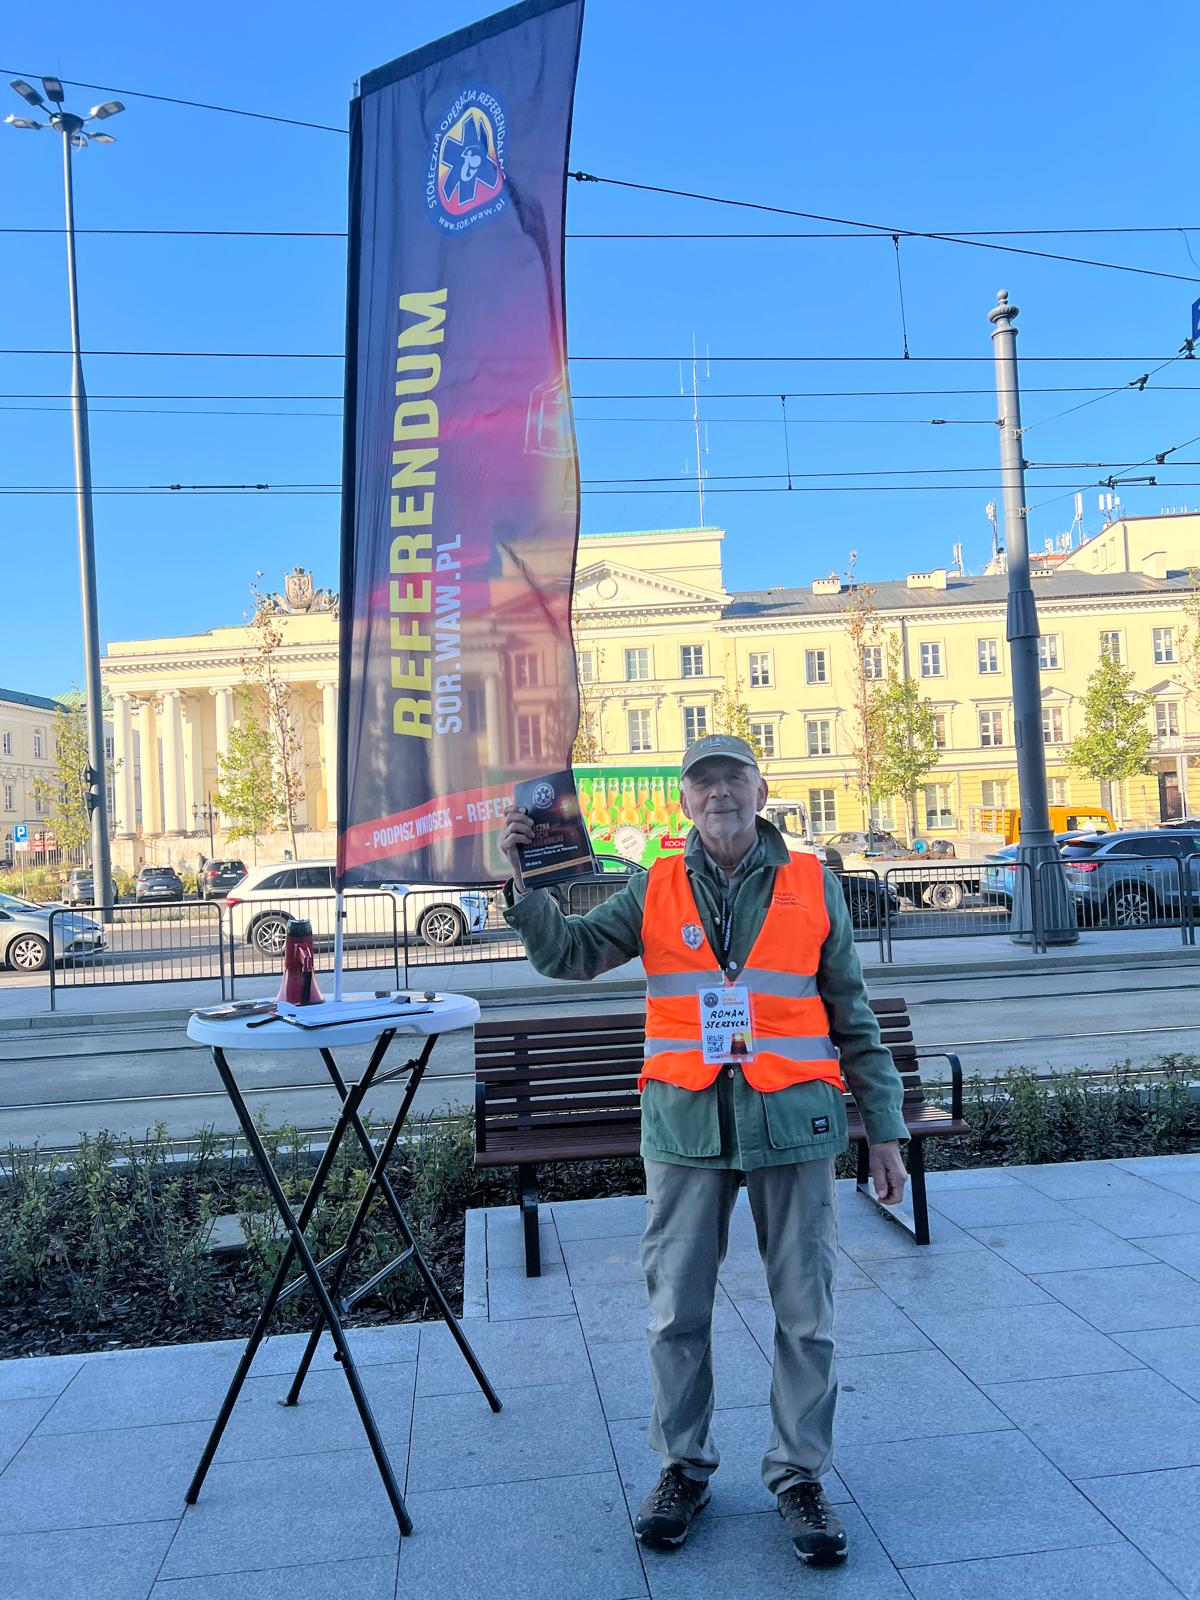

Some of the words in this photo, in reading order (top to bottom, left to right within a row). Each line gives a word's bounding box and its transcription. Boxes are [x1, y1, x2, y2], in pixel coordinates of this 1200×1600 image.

[426, 133, 442, 209] STOŁECZNA
[441, 90, 477, 131] OPERACJA
[390, 287, 448, 740] REFERENDUM
[434, 533, 463, 736] SOR.WAW.PL
[17, 826, 26, 838] P
[373, 820, 415, 848] PODPISZ
[415, 807, 453, 837] WNIOSEK
[710, 1008, 745, 1020] ROMAN
